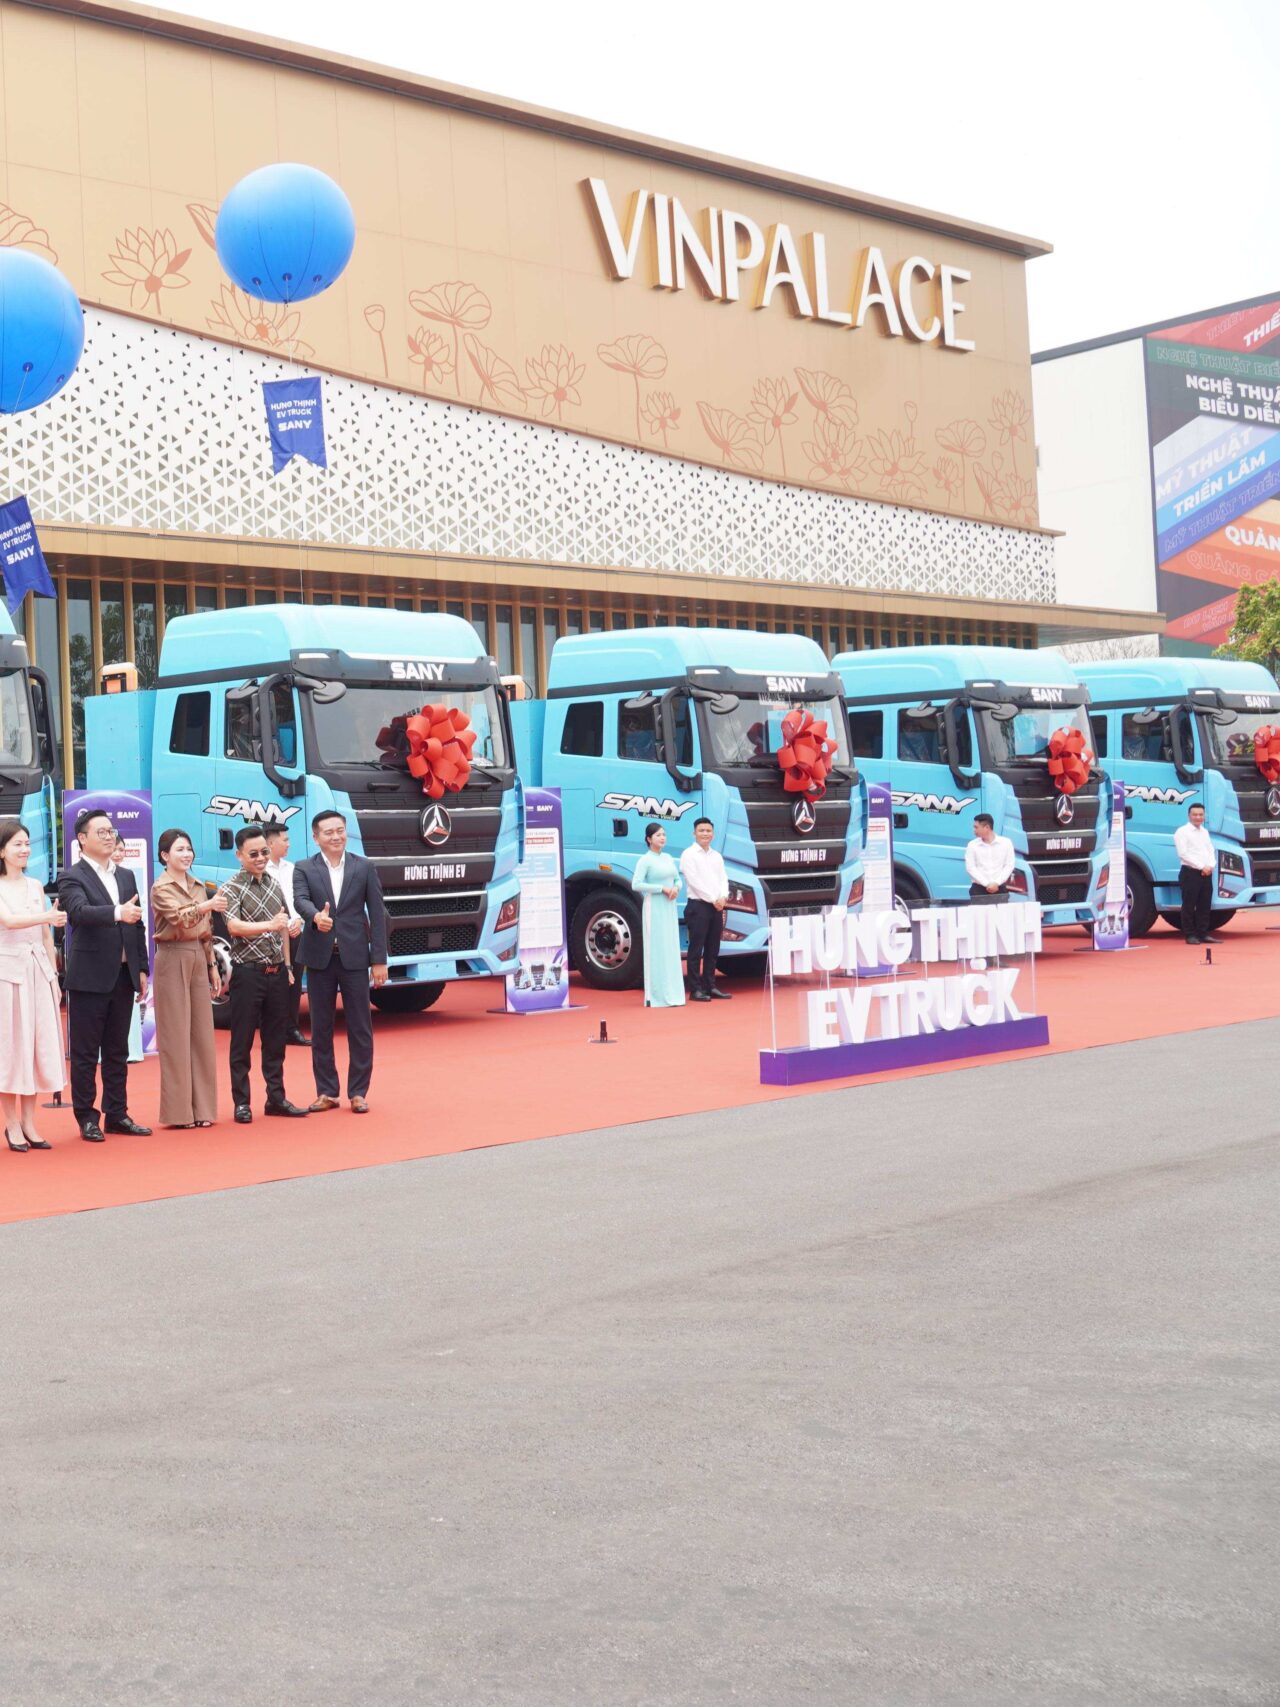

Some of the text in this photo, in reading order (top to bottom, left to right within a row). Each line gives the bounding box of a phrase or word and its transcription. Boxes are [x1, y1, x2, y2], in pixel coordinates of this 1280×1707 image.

[582, 177, 975, 351] VINPALACE
[1185, 374, 1233, 400] NGHỆ
[276, 408, 312, 419] EV TRUCK
[1198, 396, 1239, 417] BIỂU
[278, 419, 313, 432] SANY
[1155, 426, 1254, 501] MỸ THUẬT
[1173, 449, 1266, 518] TRIỂN LÃM
[11, 532, 33, 547] TRUCK
[6, 545, 35, 566] SANY
[1186, 549, 1252, 580] QUẢNG
[390, 661, 445, 681] SANY
[766, 676, 806, 693] SANY
[1031, 687, 1063, 702] SANY
[1244, 695, 1271, 708] SANY
[117, 811, 140, 819] SANY
[202, 795, 303, 825] SANY
[596, 792, 699, 818] SANY
[781, 847, 827, 864] HƯNG THỊNH EV
[404, 862, 466, 882] HƯNG THỊNH EV
[771, 901, 1042, 975] HƯNG THỊNH
[807, 967, 1021, 1049] EV TRUCK
